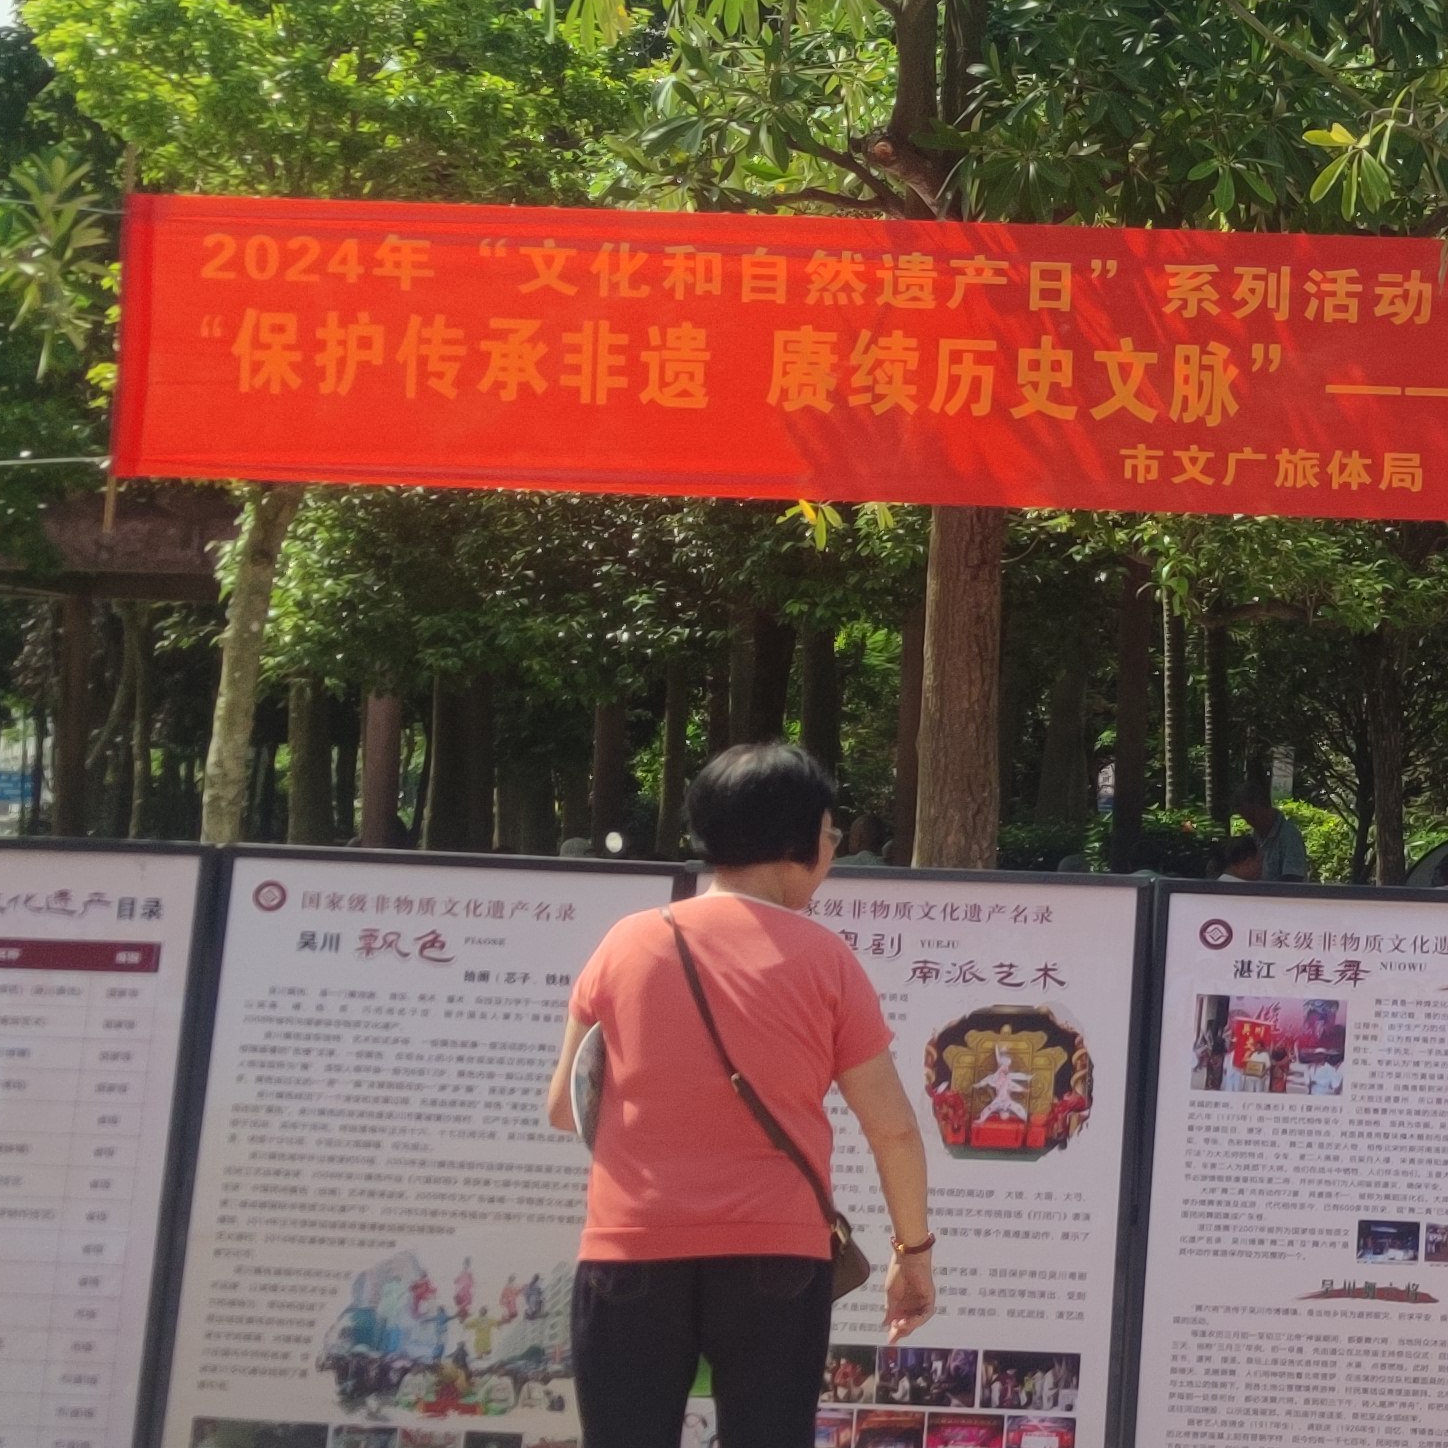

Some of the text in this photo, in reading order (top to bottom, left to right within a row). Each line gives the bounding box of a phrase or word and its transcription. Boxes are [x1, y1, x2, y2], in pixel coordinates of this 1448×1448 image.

[201, 233, 1432, 326] 2024年 “文化和自然遗产日” 系列活动
[199, 308, 710, 411] “保护传承非遗
[765, 322, 1283, 427] 赓续历史文脉”
[1119, 443, 1423, 493] 市文广旅体局
[301, 890, 577, 922] 国家级非物质文化遗产名录
[296, 930, 342, 954] 吴川
[904, 959, 1067, 990] 南派艺术
[1233, 959, 1276, 979] 湛江
[1380, 961, 1428, 972] NUOWU
